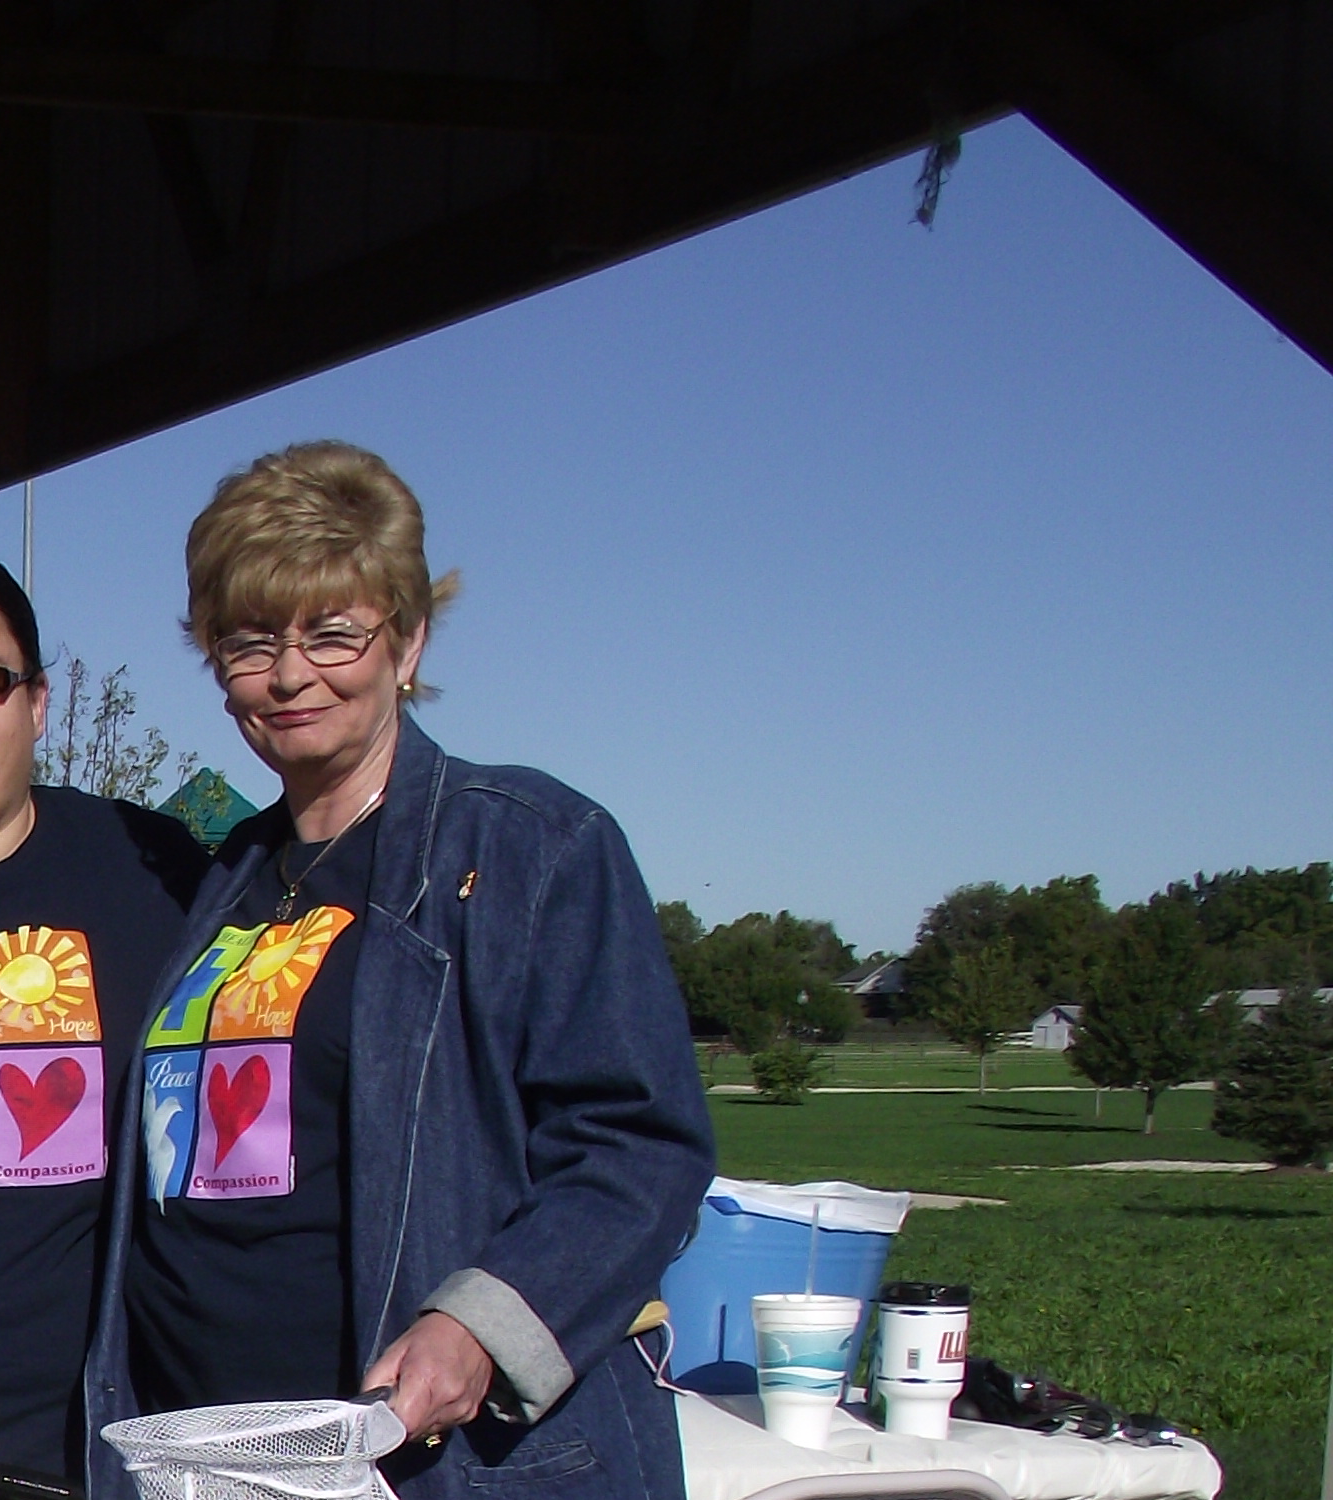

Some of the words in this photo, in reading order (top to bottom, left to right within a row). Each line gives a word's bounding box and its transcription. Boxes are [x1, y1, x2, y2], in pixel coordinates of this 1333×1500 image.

[48, 1017, 96, 1036] Hope
[254, 1005, 291, 1029] Hope
[149, 1056, 195, 1089] Peace
[193, 1173, 280, 1191] Compassion
